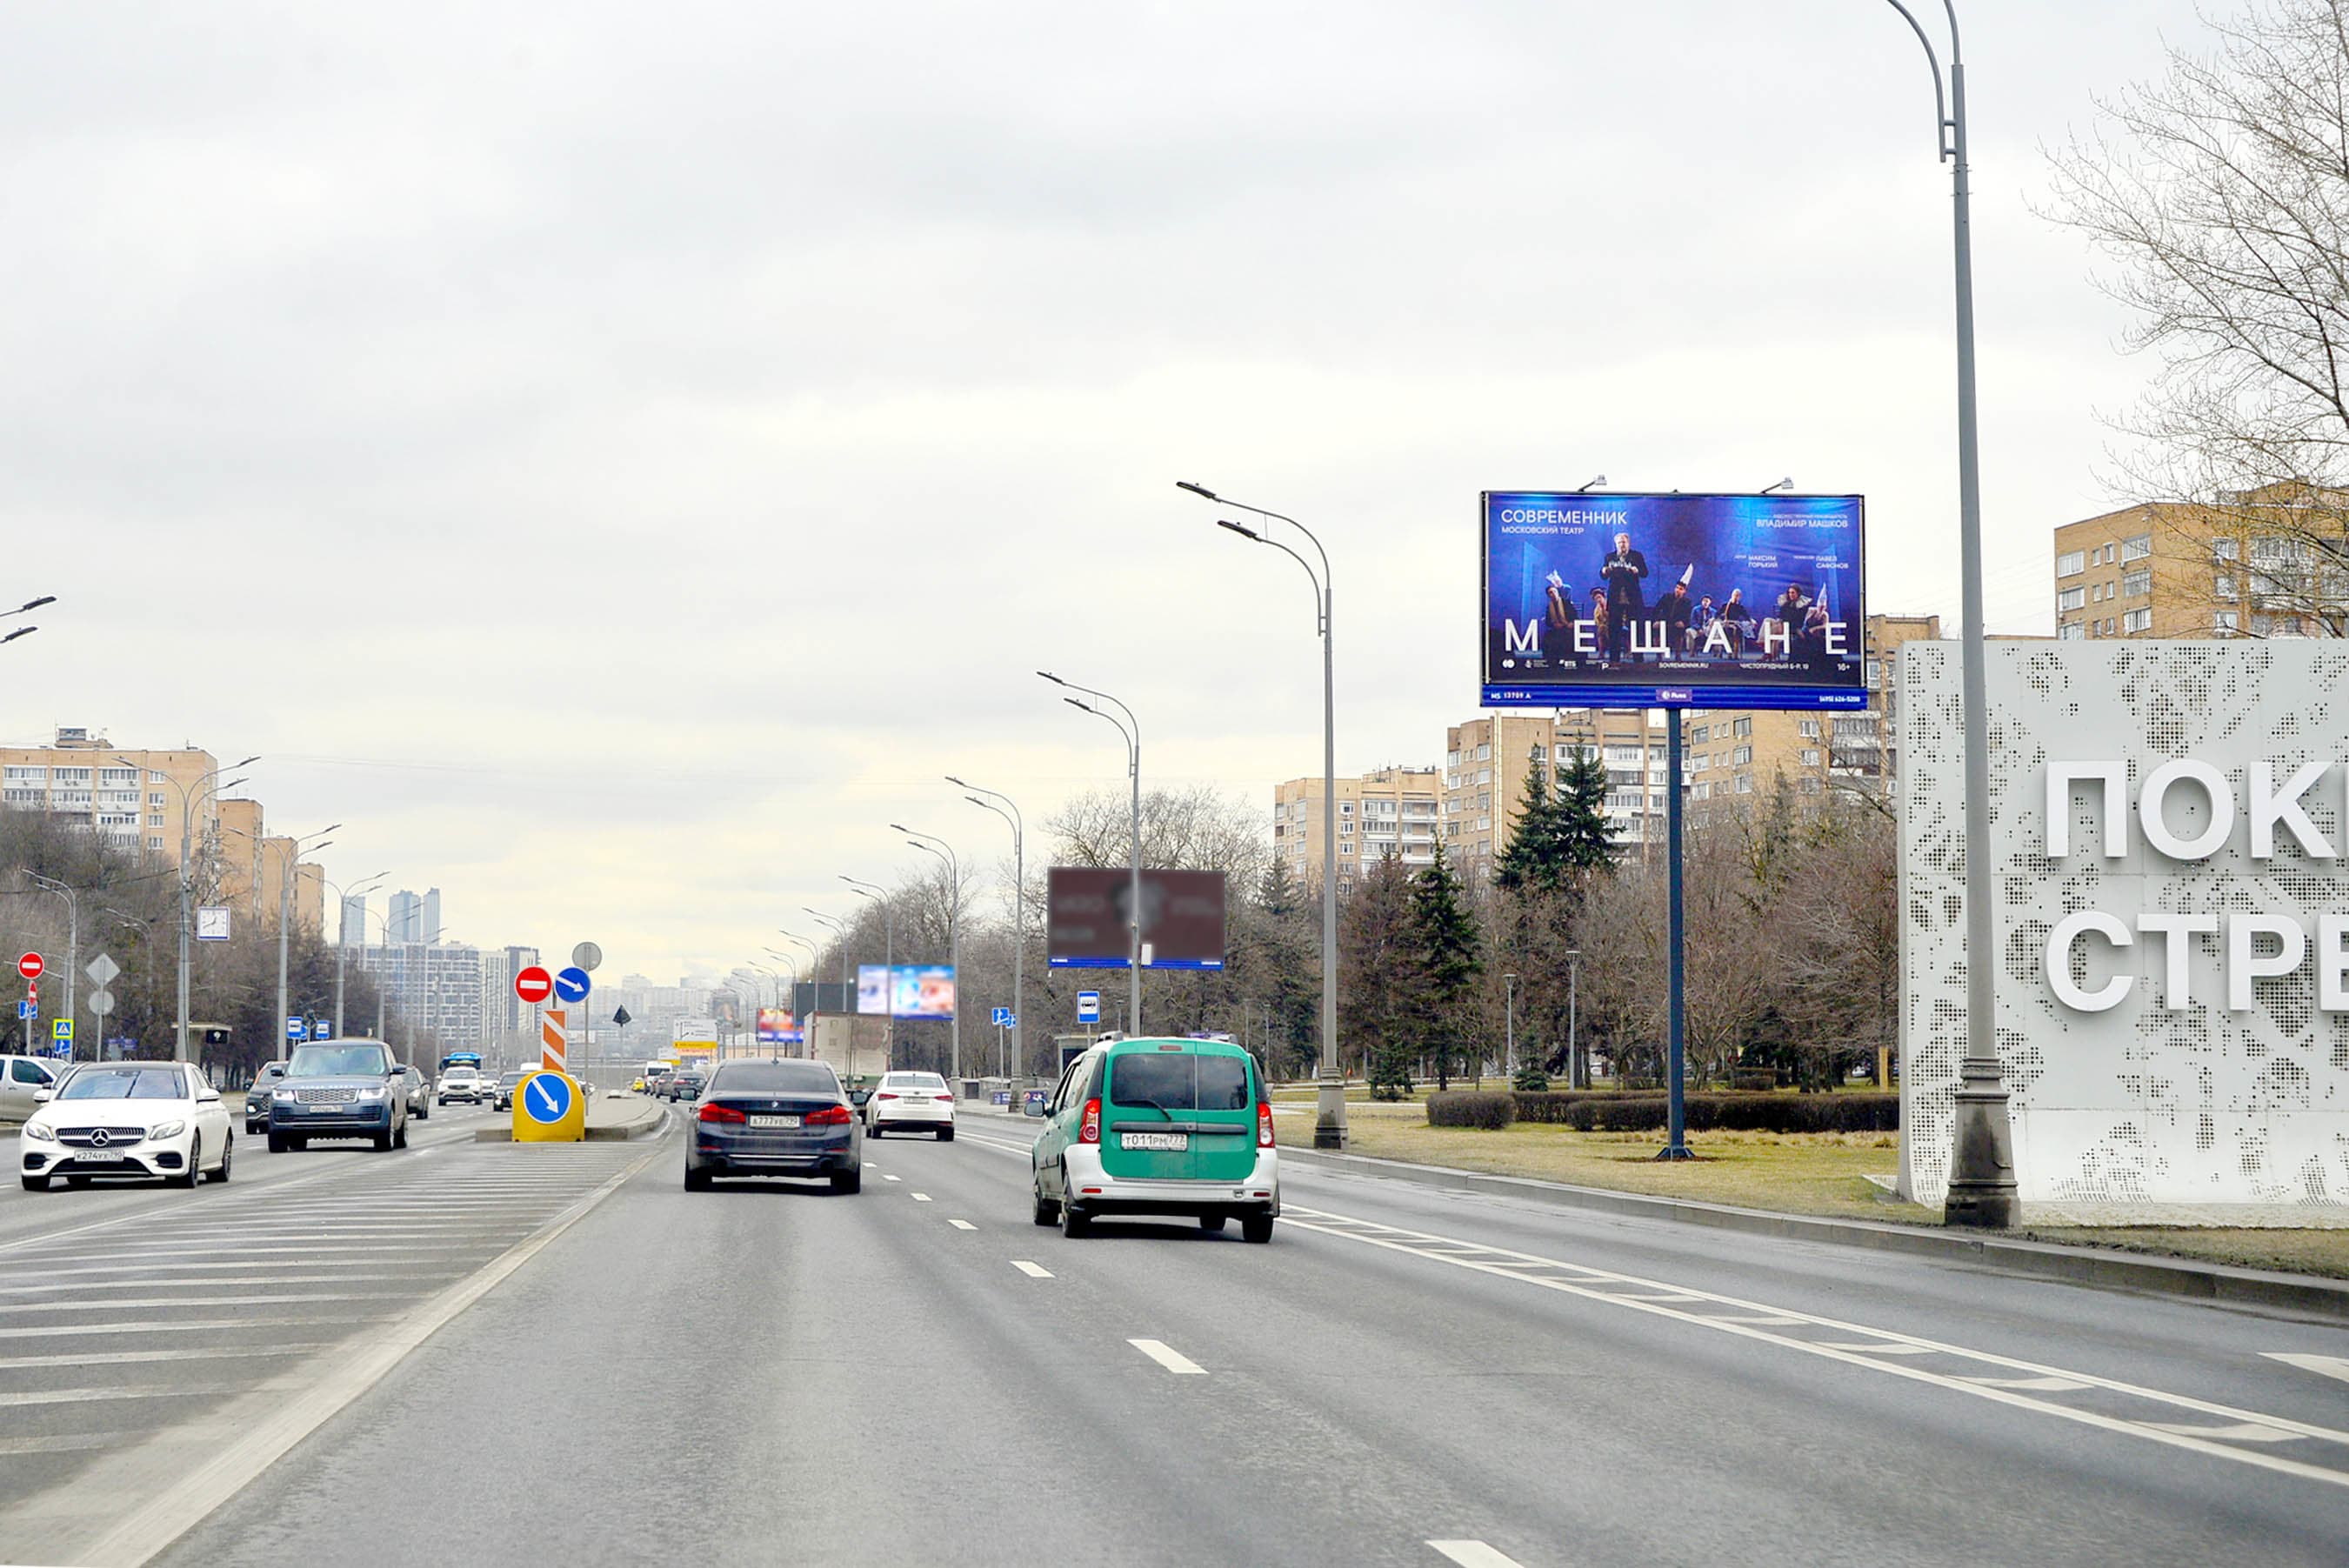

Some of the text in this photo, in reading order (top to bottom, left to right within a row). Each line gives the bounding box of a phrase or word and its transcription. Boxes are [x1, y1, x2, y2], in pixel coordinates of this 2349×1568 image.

[1501, 510, 1627, 524] СОВРЕМЕННИК
[1505, 619, 1848, 657] МЕЩАНЕ
[2045, 758, 2349, 859] ПОК
